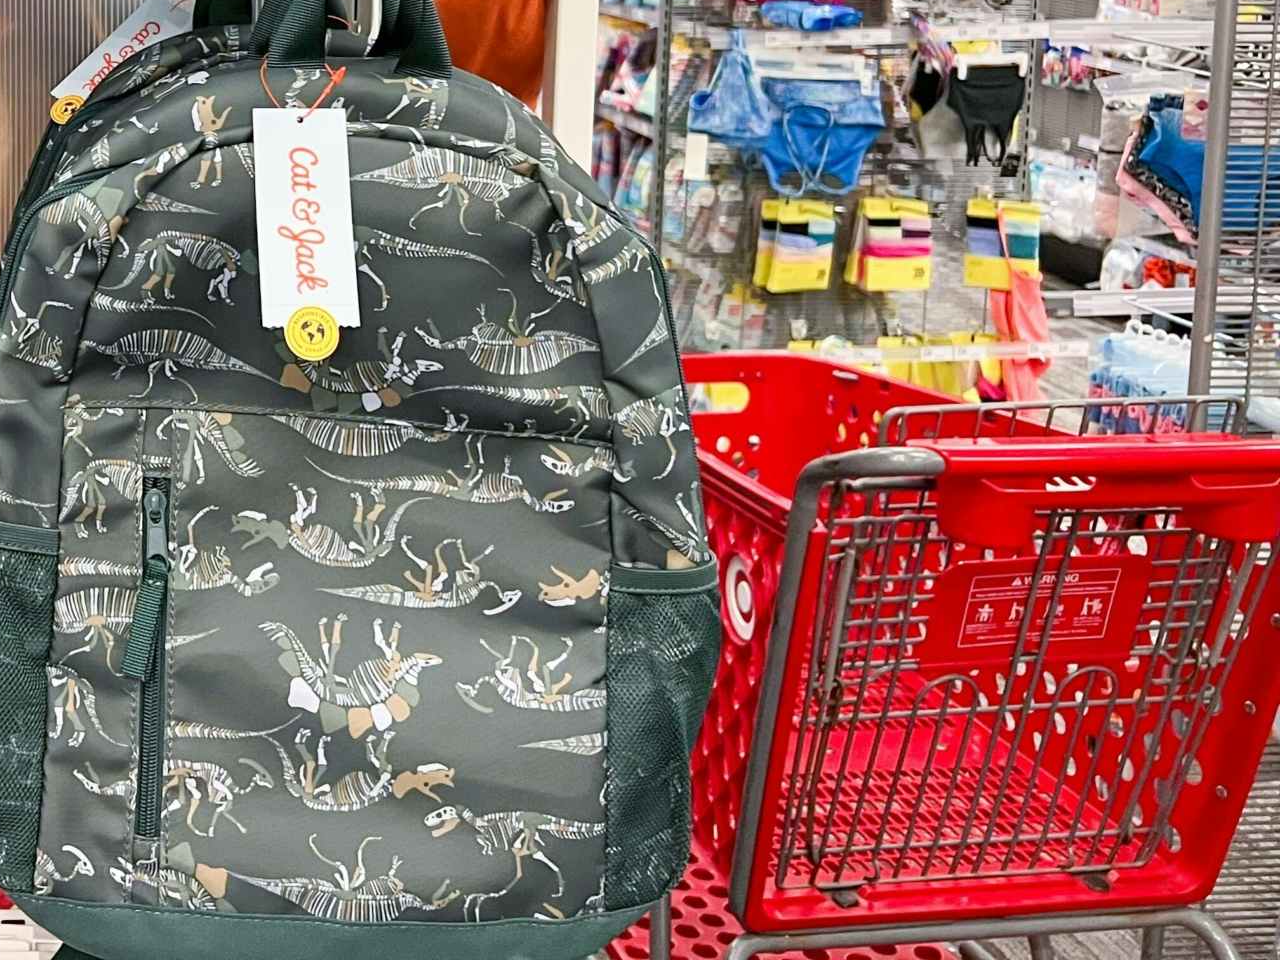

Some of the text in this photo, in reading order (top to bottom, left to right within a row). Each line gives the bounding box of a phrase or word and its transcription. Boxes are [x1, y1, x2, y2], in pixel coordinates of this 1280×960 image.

[132, 21, 161, 46] Cat
[82, 52, 121, 91] Jack
[288, 146, 319, 193] Cat
[291, 198, 321, 226] &
[277, 225, 329, 296] Jack
[1023, 573, 1080, 586] WRNNG
